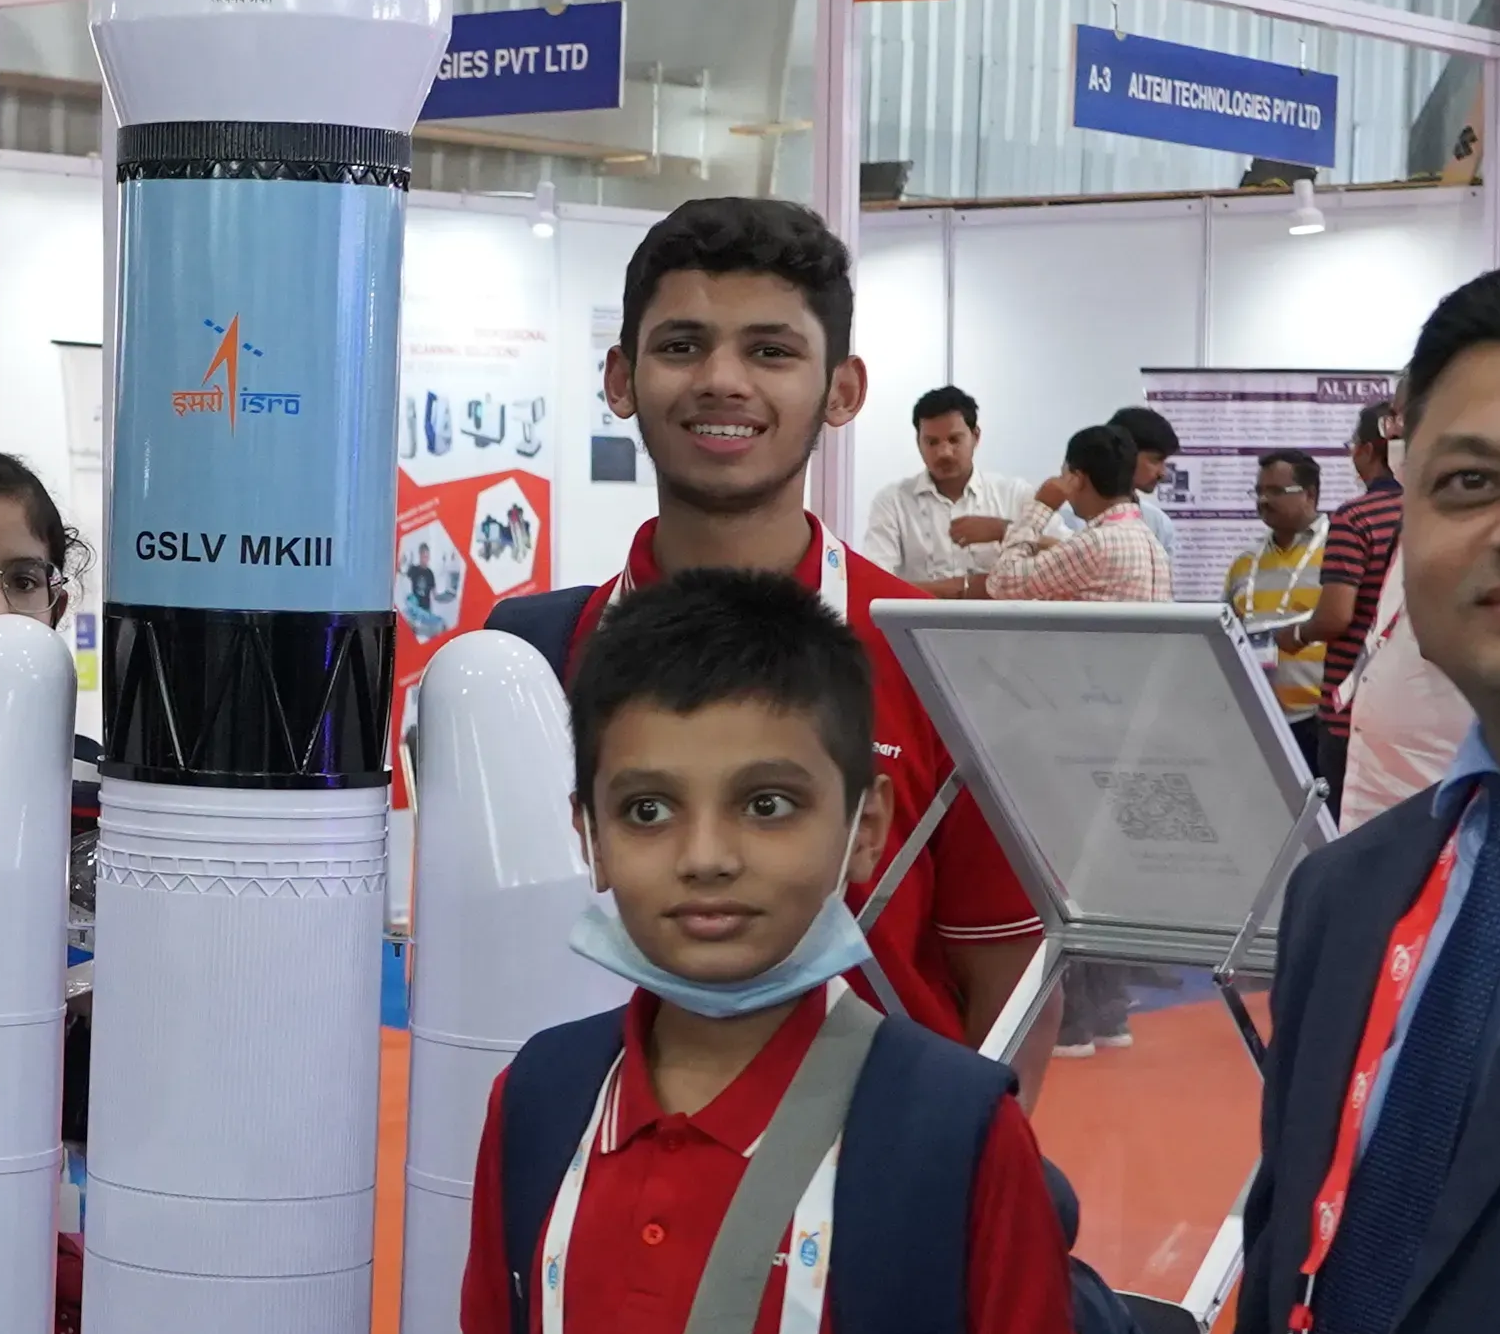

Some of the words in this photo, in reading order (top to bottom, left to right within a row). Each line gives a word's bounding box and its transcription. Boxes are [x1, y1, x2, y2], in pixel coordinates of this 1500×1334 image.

[493, 46, 541, 77] PVT
[544, 42, 589, 73] LTD
[1088, 64, 1112, 94] A-3
[1127, 71, 1172, 106] ALTEM
[1172, 80, 1272, 123] TECHNOLOGIES
[1272, 97, 1298, 128] PVT
[1297, 102, 1322, 131] LTD
[171, 384, 225, 418] इसरो
[239, 386, 301, 416] isro
[1318, 378, 1391, 398] ALTEM
[135, 530, 228, 564] GSLV
[239, 534, 333, 568] MKIII
